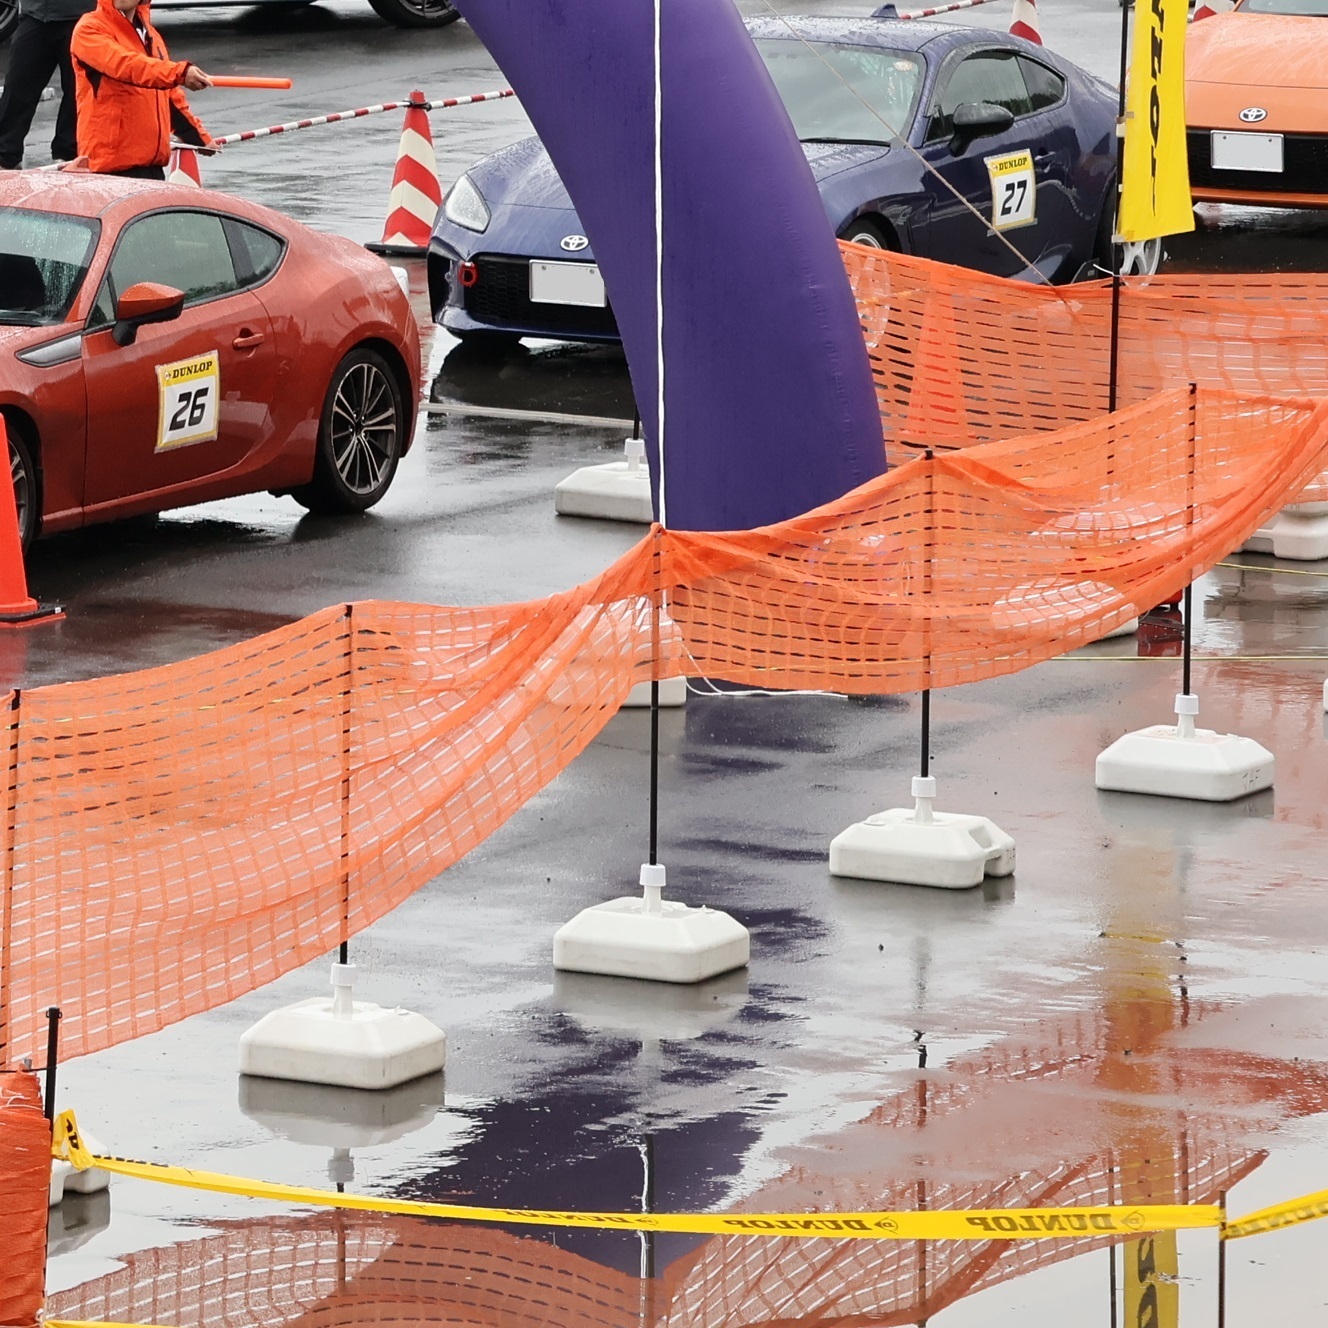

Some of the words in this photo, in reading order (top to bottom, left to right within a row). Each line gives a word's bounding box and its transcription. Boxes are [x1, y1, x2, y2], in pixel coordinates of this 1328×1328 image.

[998, 157, 1028, 171] DUNLOP
[1000, 179, 1028, 217] 27
[172, 360, 213, 379] DUNLOP
[168, 386, 210, 432] 26
